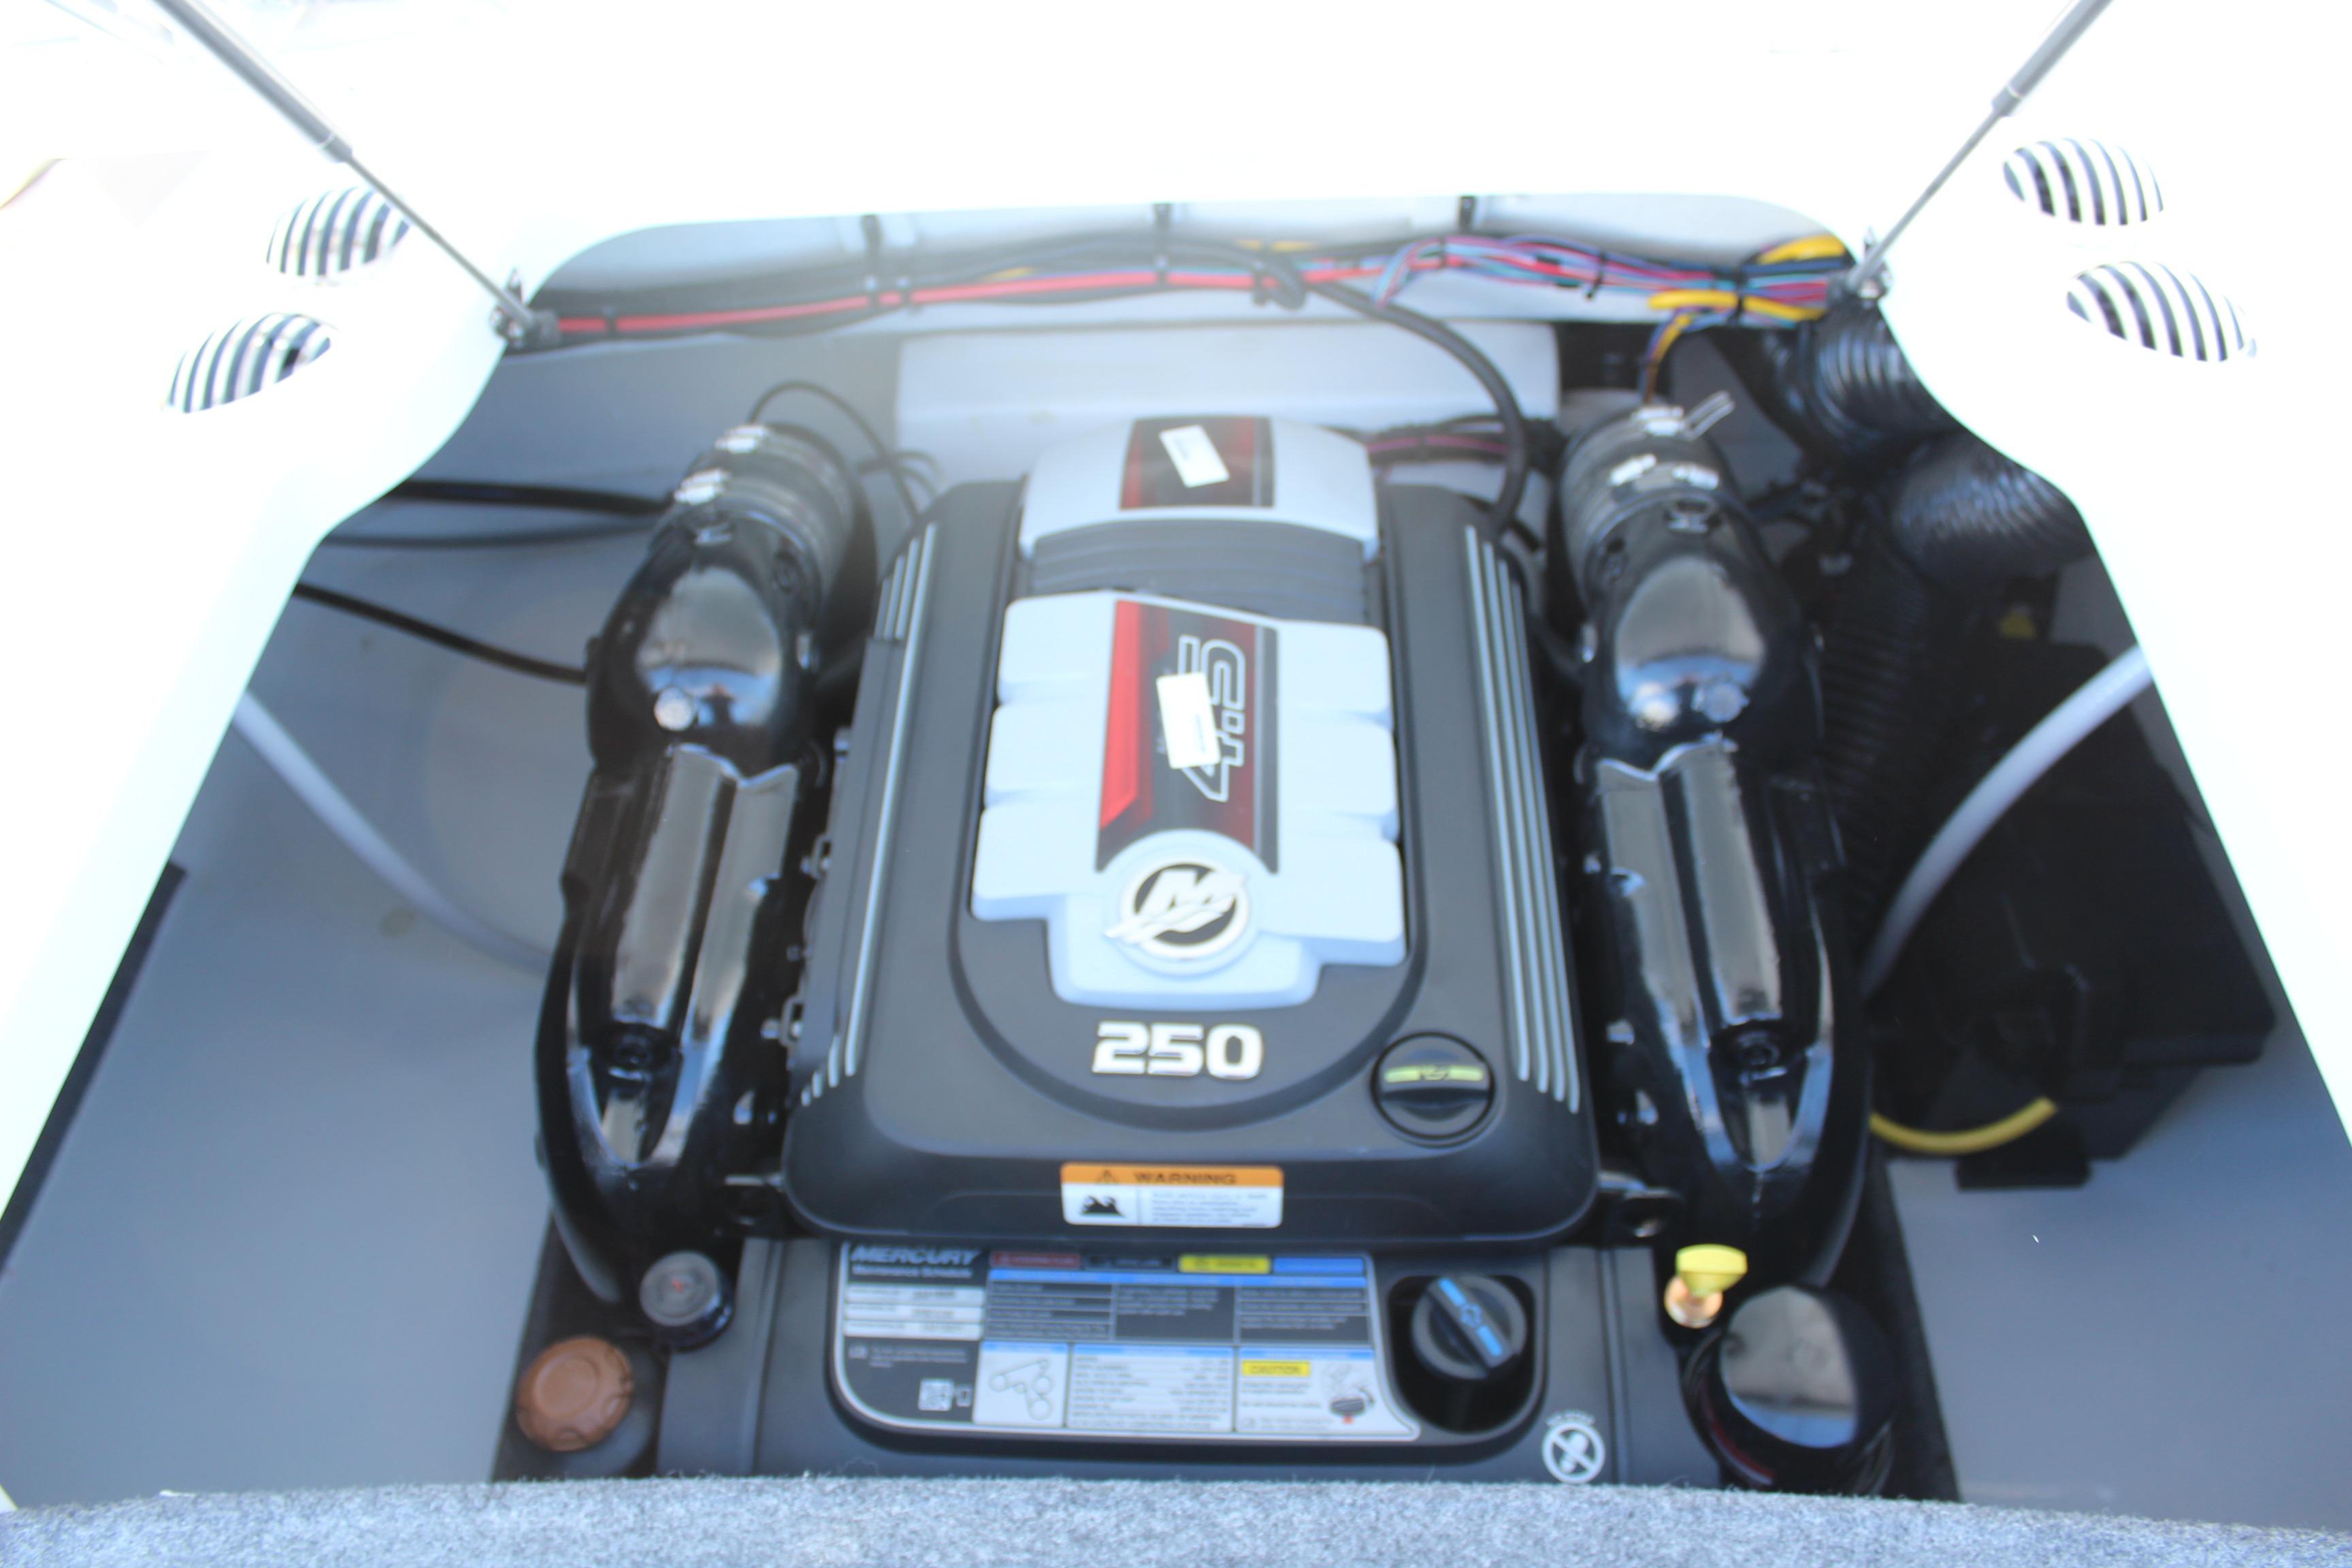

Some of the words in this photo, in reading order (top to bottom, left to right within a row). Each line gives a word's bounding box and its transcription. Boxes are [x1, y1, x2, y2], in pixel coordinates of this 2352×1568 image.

[1091, 1020, 1264, 1080] 250
[1133, 1172, 1237, 1186] WARNING
[851, 1244, 981, 1265] MERCURY
